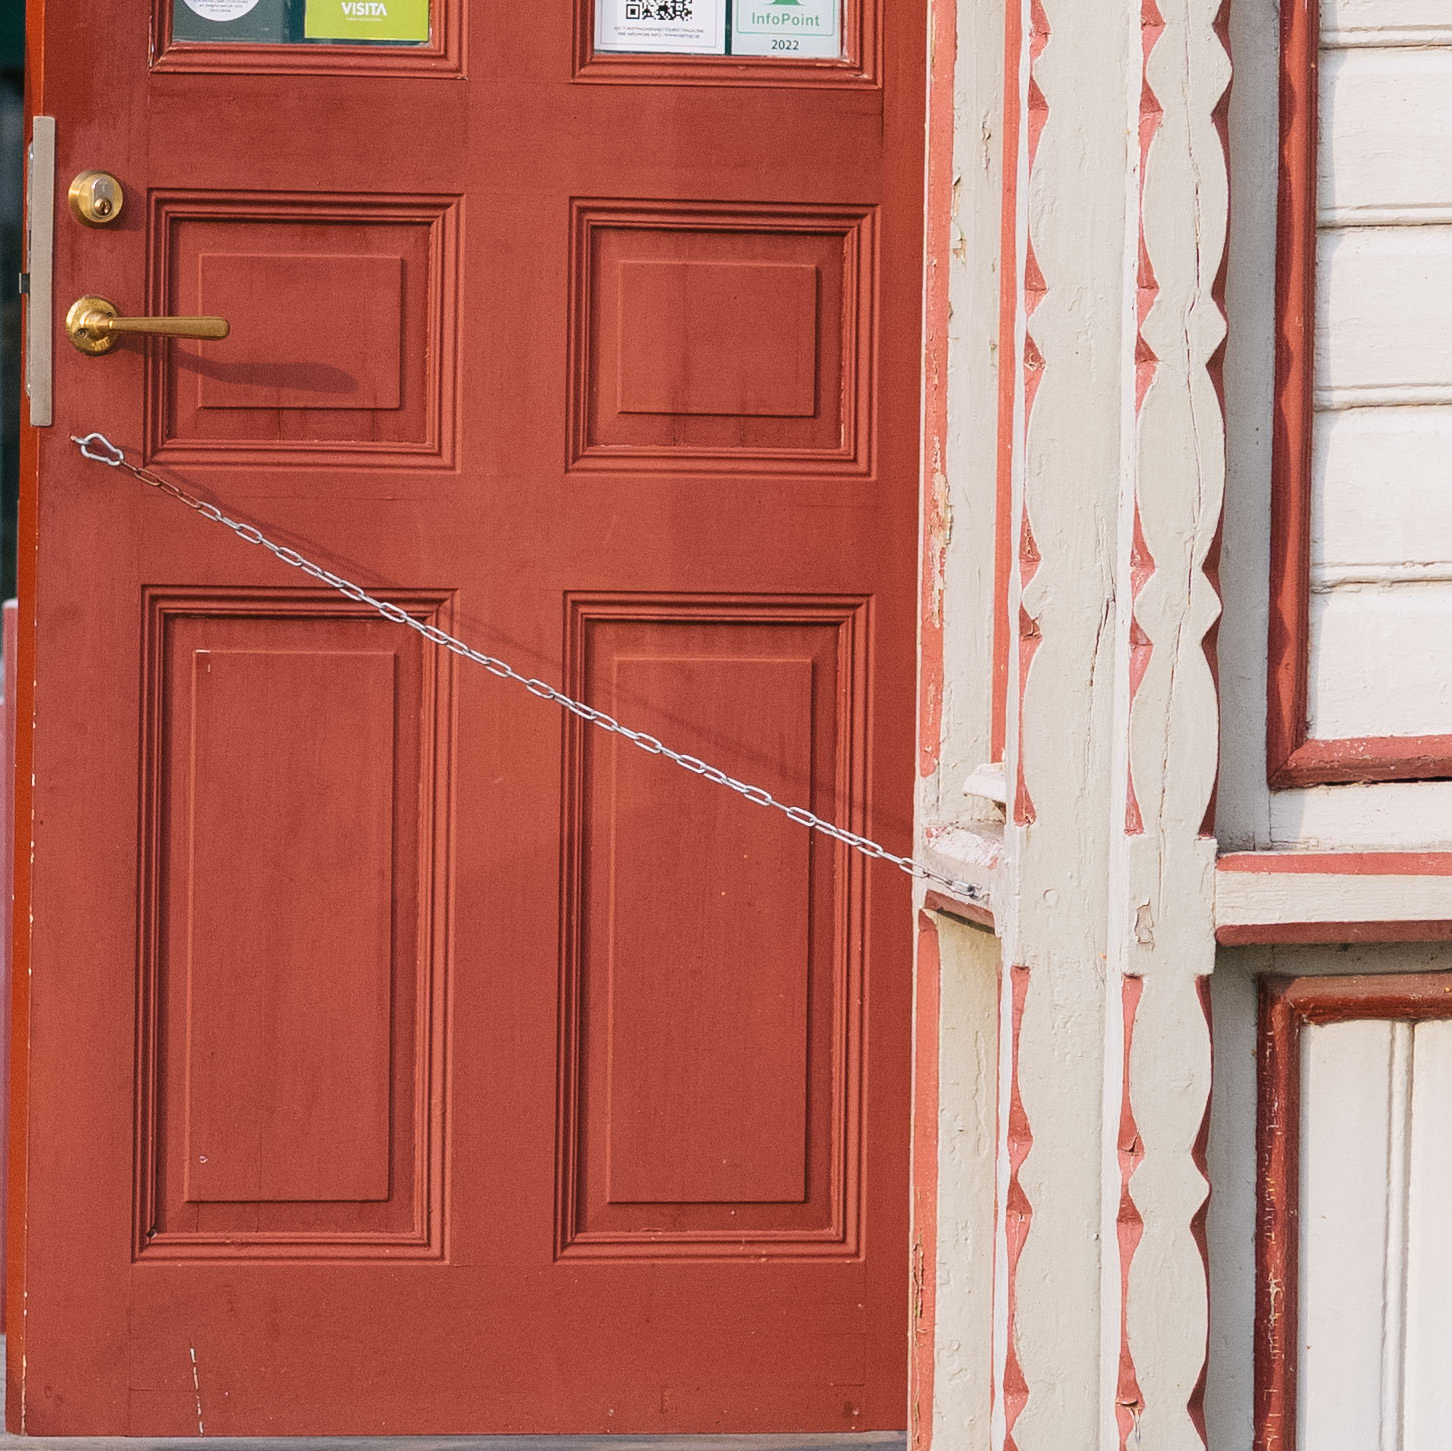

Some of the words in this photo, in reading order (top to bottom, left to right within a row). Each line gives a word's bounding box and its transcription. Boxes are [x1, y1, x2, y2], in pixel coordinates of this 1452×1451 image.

[341, 2, 388, 16] VISITA
[752, 12, 820, 26] InfoPoint
[771, 39, 799, 50] 2022
